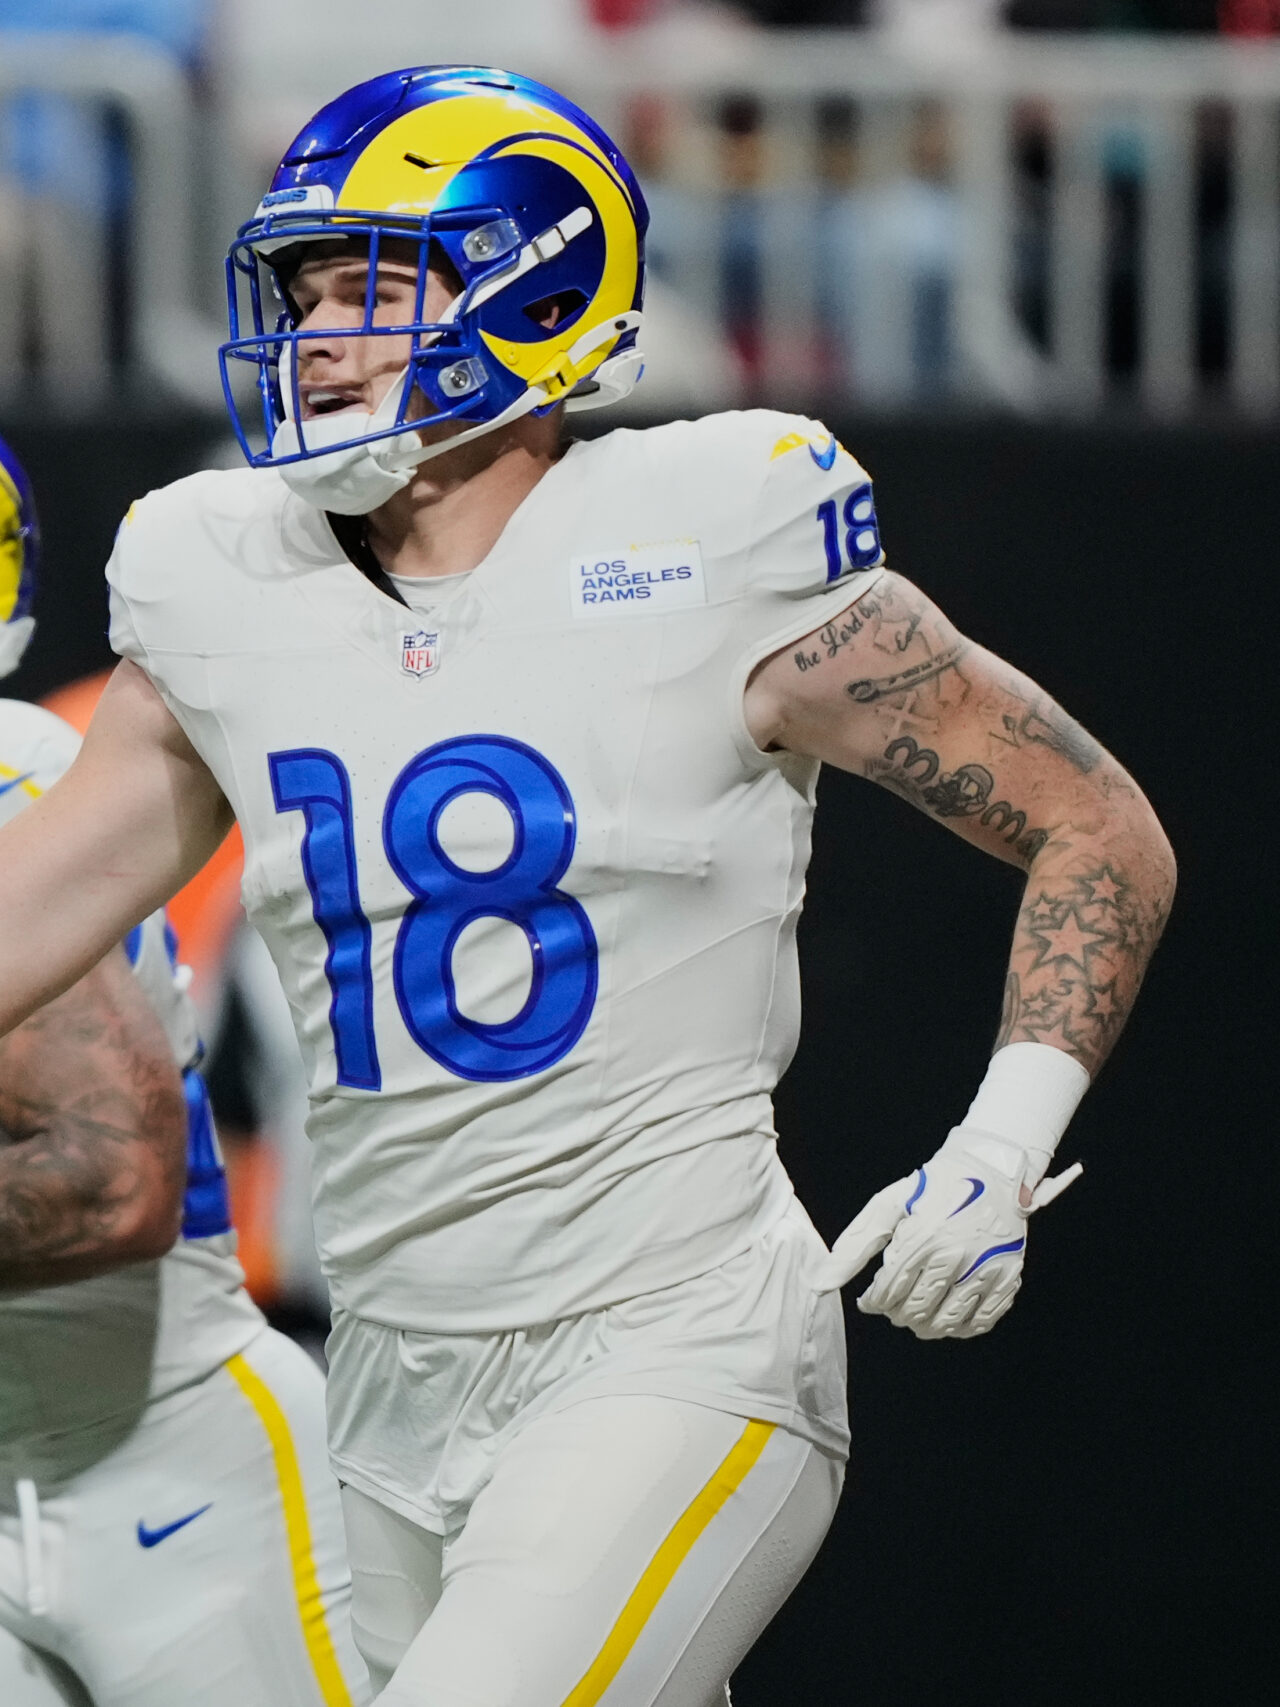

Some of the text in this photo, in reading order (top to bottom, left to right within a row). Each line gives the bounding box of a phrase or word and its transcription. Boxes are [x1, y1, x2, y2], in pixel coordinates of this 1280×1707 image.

[816, 481, 881, 585] 18
[580, 560, 627, 577] LOS
[581, 566, 693, 591] ANGELES
[582, 586, 652, 605] RAMS
[820, 611, 864, 657] Lord
[405, 650, 433, 671] NFL
[267, 733, 599, 1092] 18
